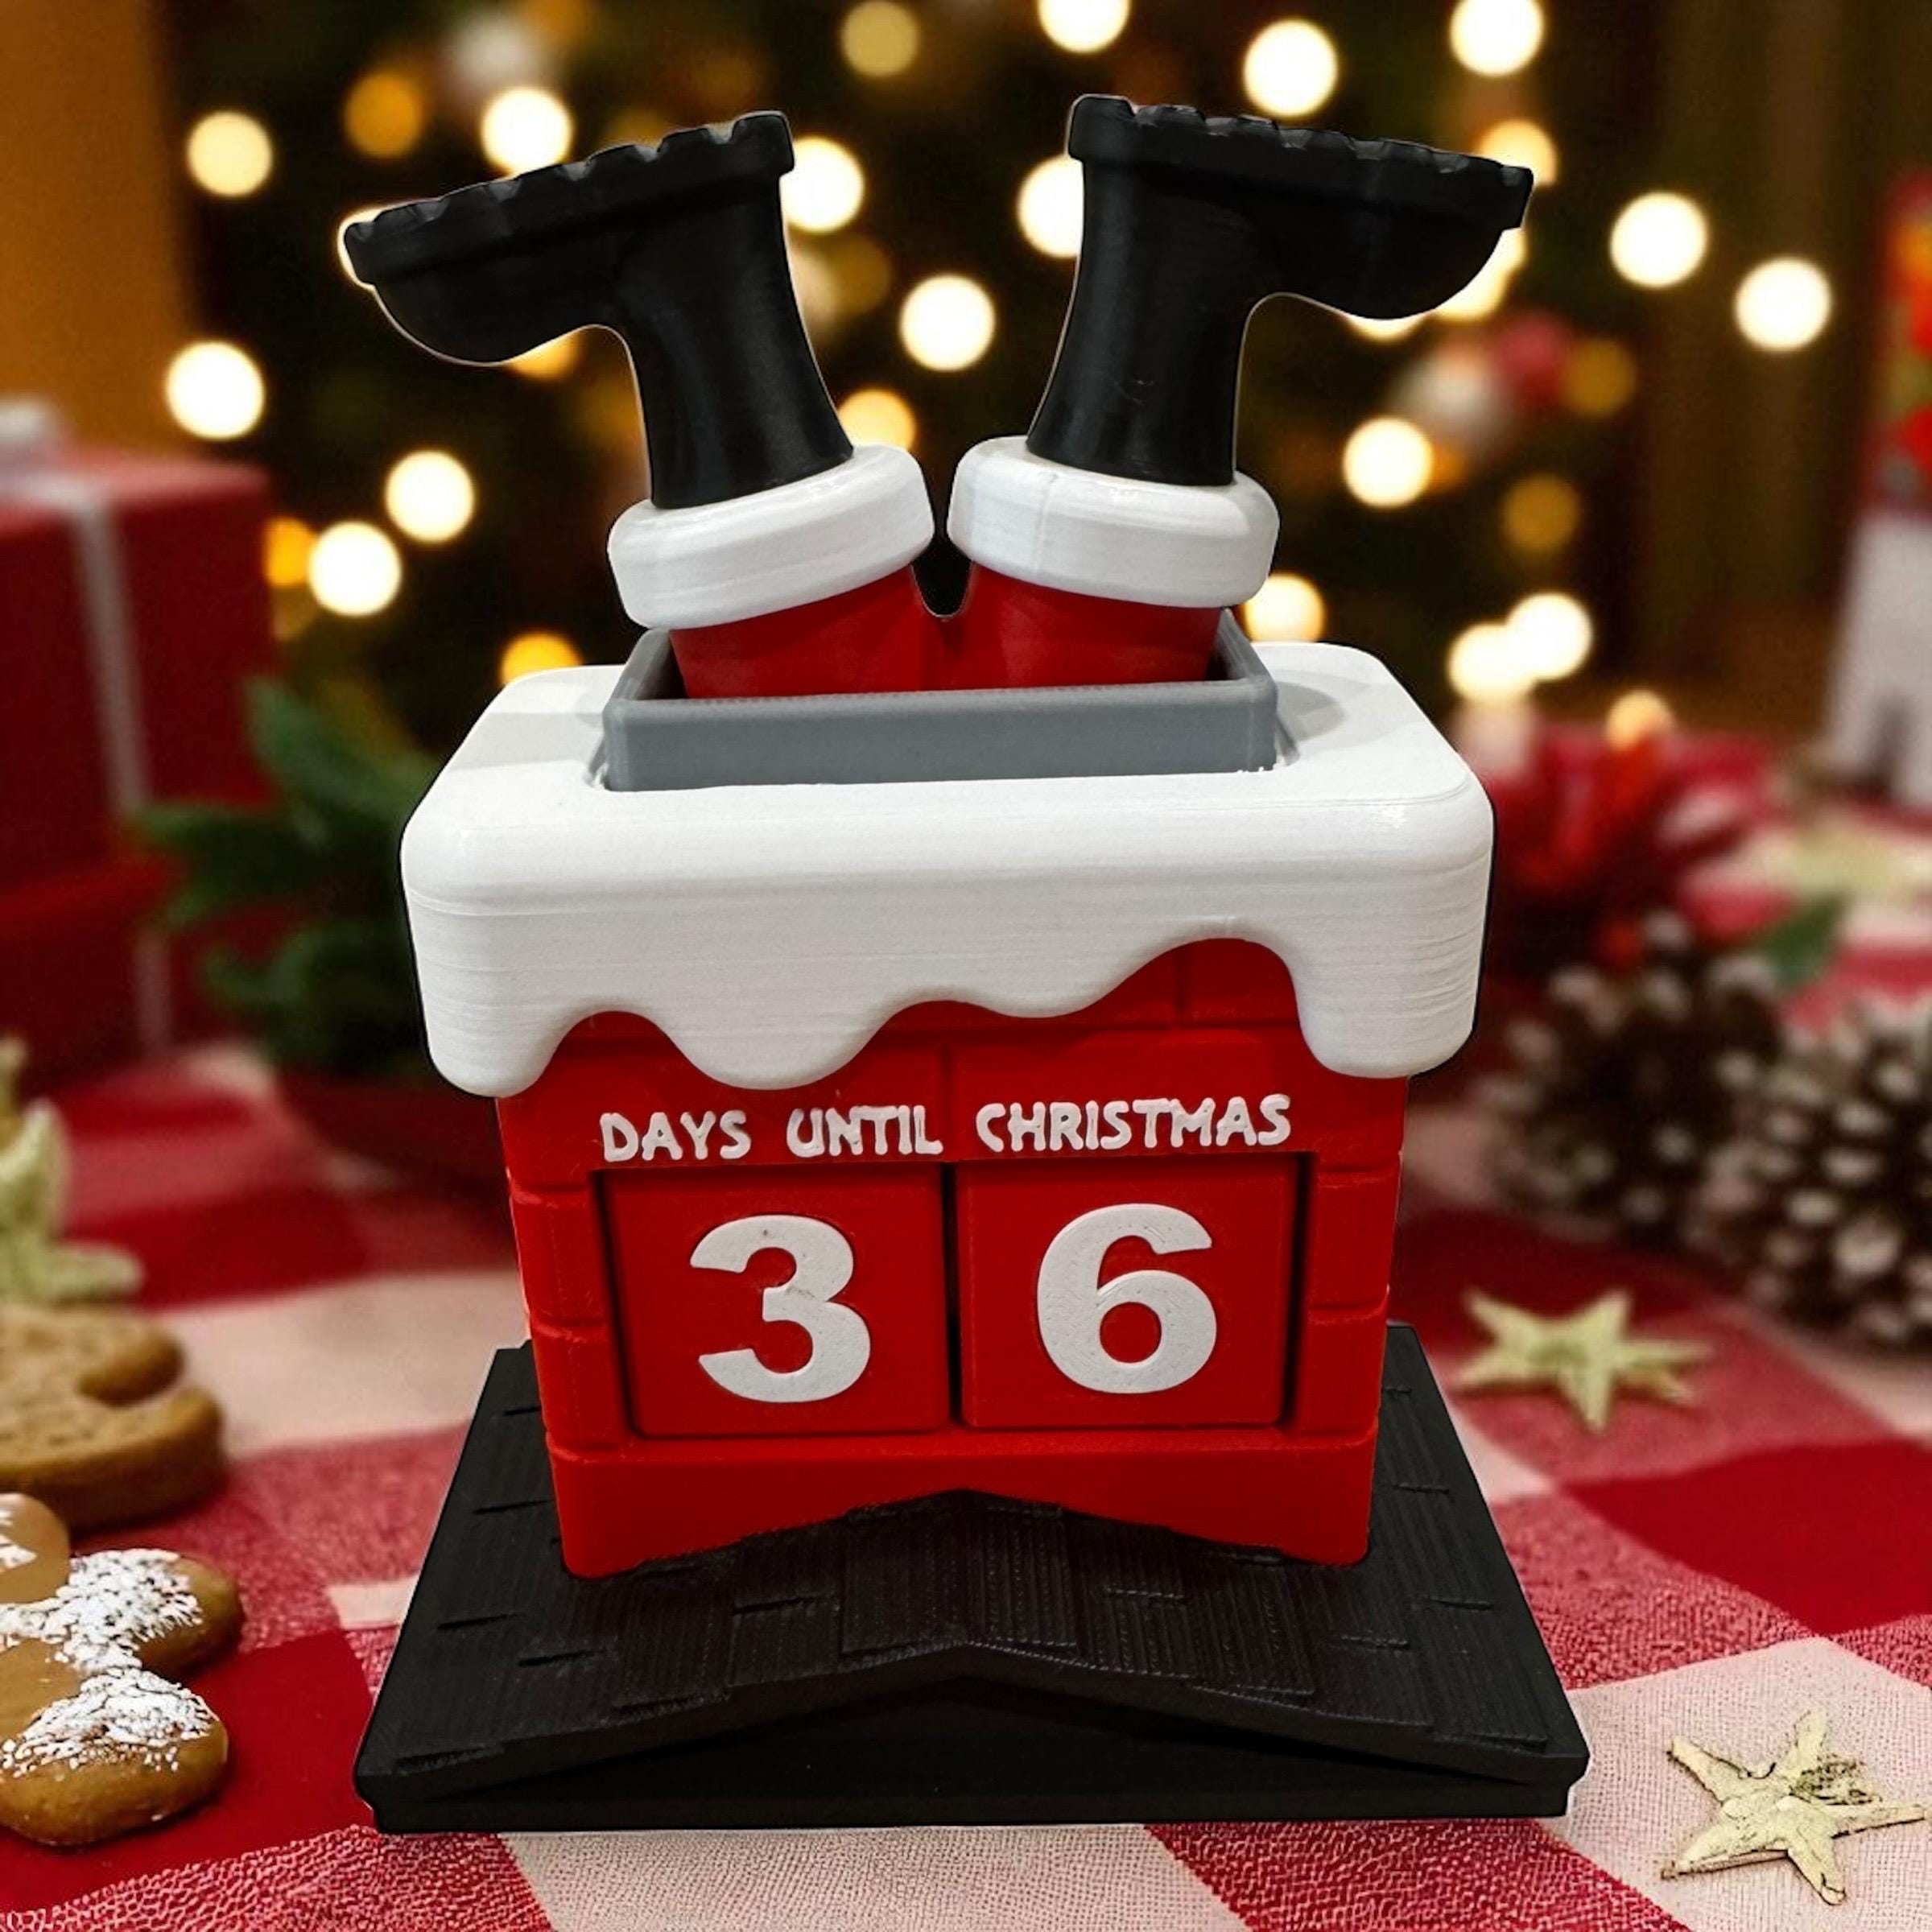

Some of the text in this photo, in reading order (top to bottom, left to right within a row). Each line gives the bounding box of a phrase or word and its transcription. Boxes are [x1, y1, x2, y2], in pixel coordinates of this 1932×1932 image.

[599, 1093, 1291, 1162] DAYS UNTIL CHRISTMAS
